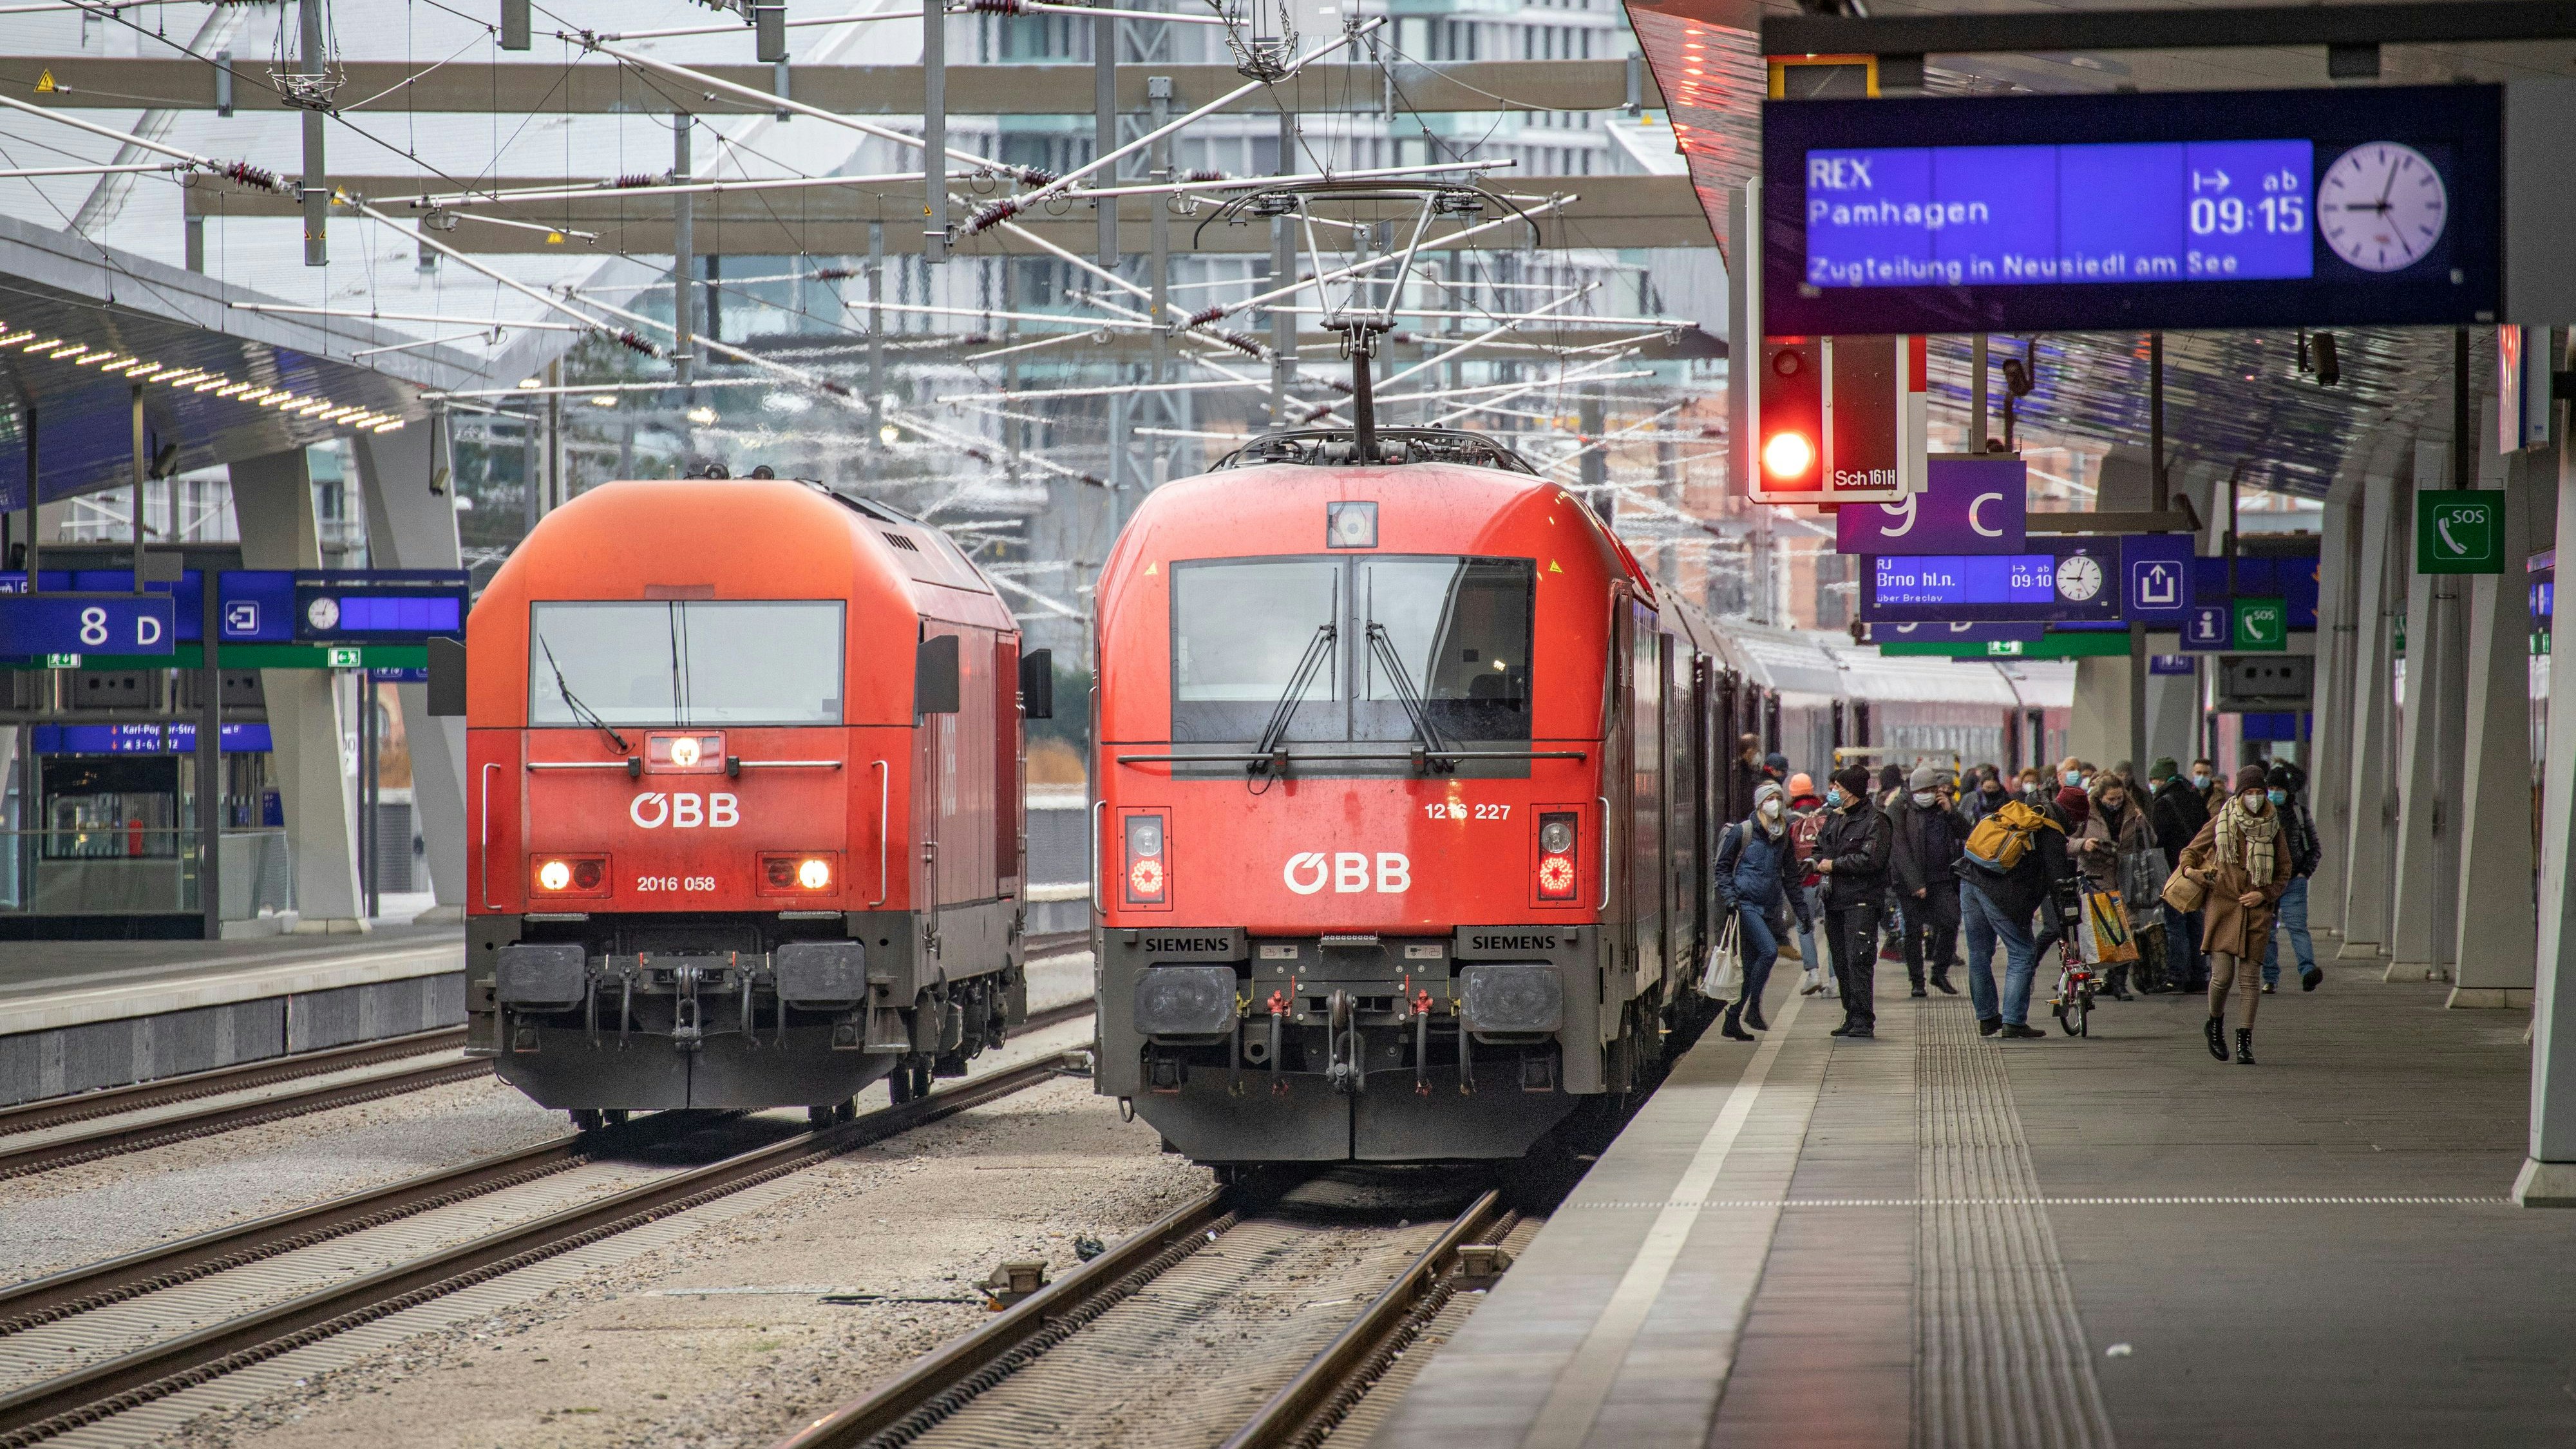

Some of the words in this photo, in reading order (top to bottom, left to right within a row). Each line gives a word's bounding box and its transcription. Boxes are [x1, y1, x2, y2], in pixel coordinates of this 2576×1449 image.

[1809, 158, 1871, 189] REX
[2264, 167, 2298, 191] ab
[1809, 198, 1989, 230] Pamhagen
[2191, 196, 2305, 234] 09:15
[1809, 256, 1962, 287] Zugteilung
[1969, 254, 1994, 278] in
[2003, 252, 2125, 278] Neusiedl
[2134, 256, 2178, 275] am
[2188, 251, 2237, 274] See
[1969, 493, 2003, 536] C
[2452, 510, 2485, 524] SOS
[1877, 559, 1892, 570] RJ
[1877, 573, 1915, 587] Brno
[1923, 572, 1955, 587] hl.n.
[2011, 574, 2052, 587] 09:10
[1877, 594, 1899, 602] über
[1903, 594, 1942, 602] Breclav
[2254, 610, 2275, 620] SOS
[80, 607, 108, 645] 8
[137, 616, 161, 645] D
[630, 792, 739, 828] ÖBB
[1425, 803, 1468, 819] 1216
[1475, 804, 1511, 820] 227
[1283, 852, 1411, 895] ÖBB
[637, 876, 677, 891] 2016
[684, 876, 715, 891] 058
[1146, 938, 1229, 952] SIEMENS
[1472, 936, 1555, 949] SIEMENS
